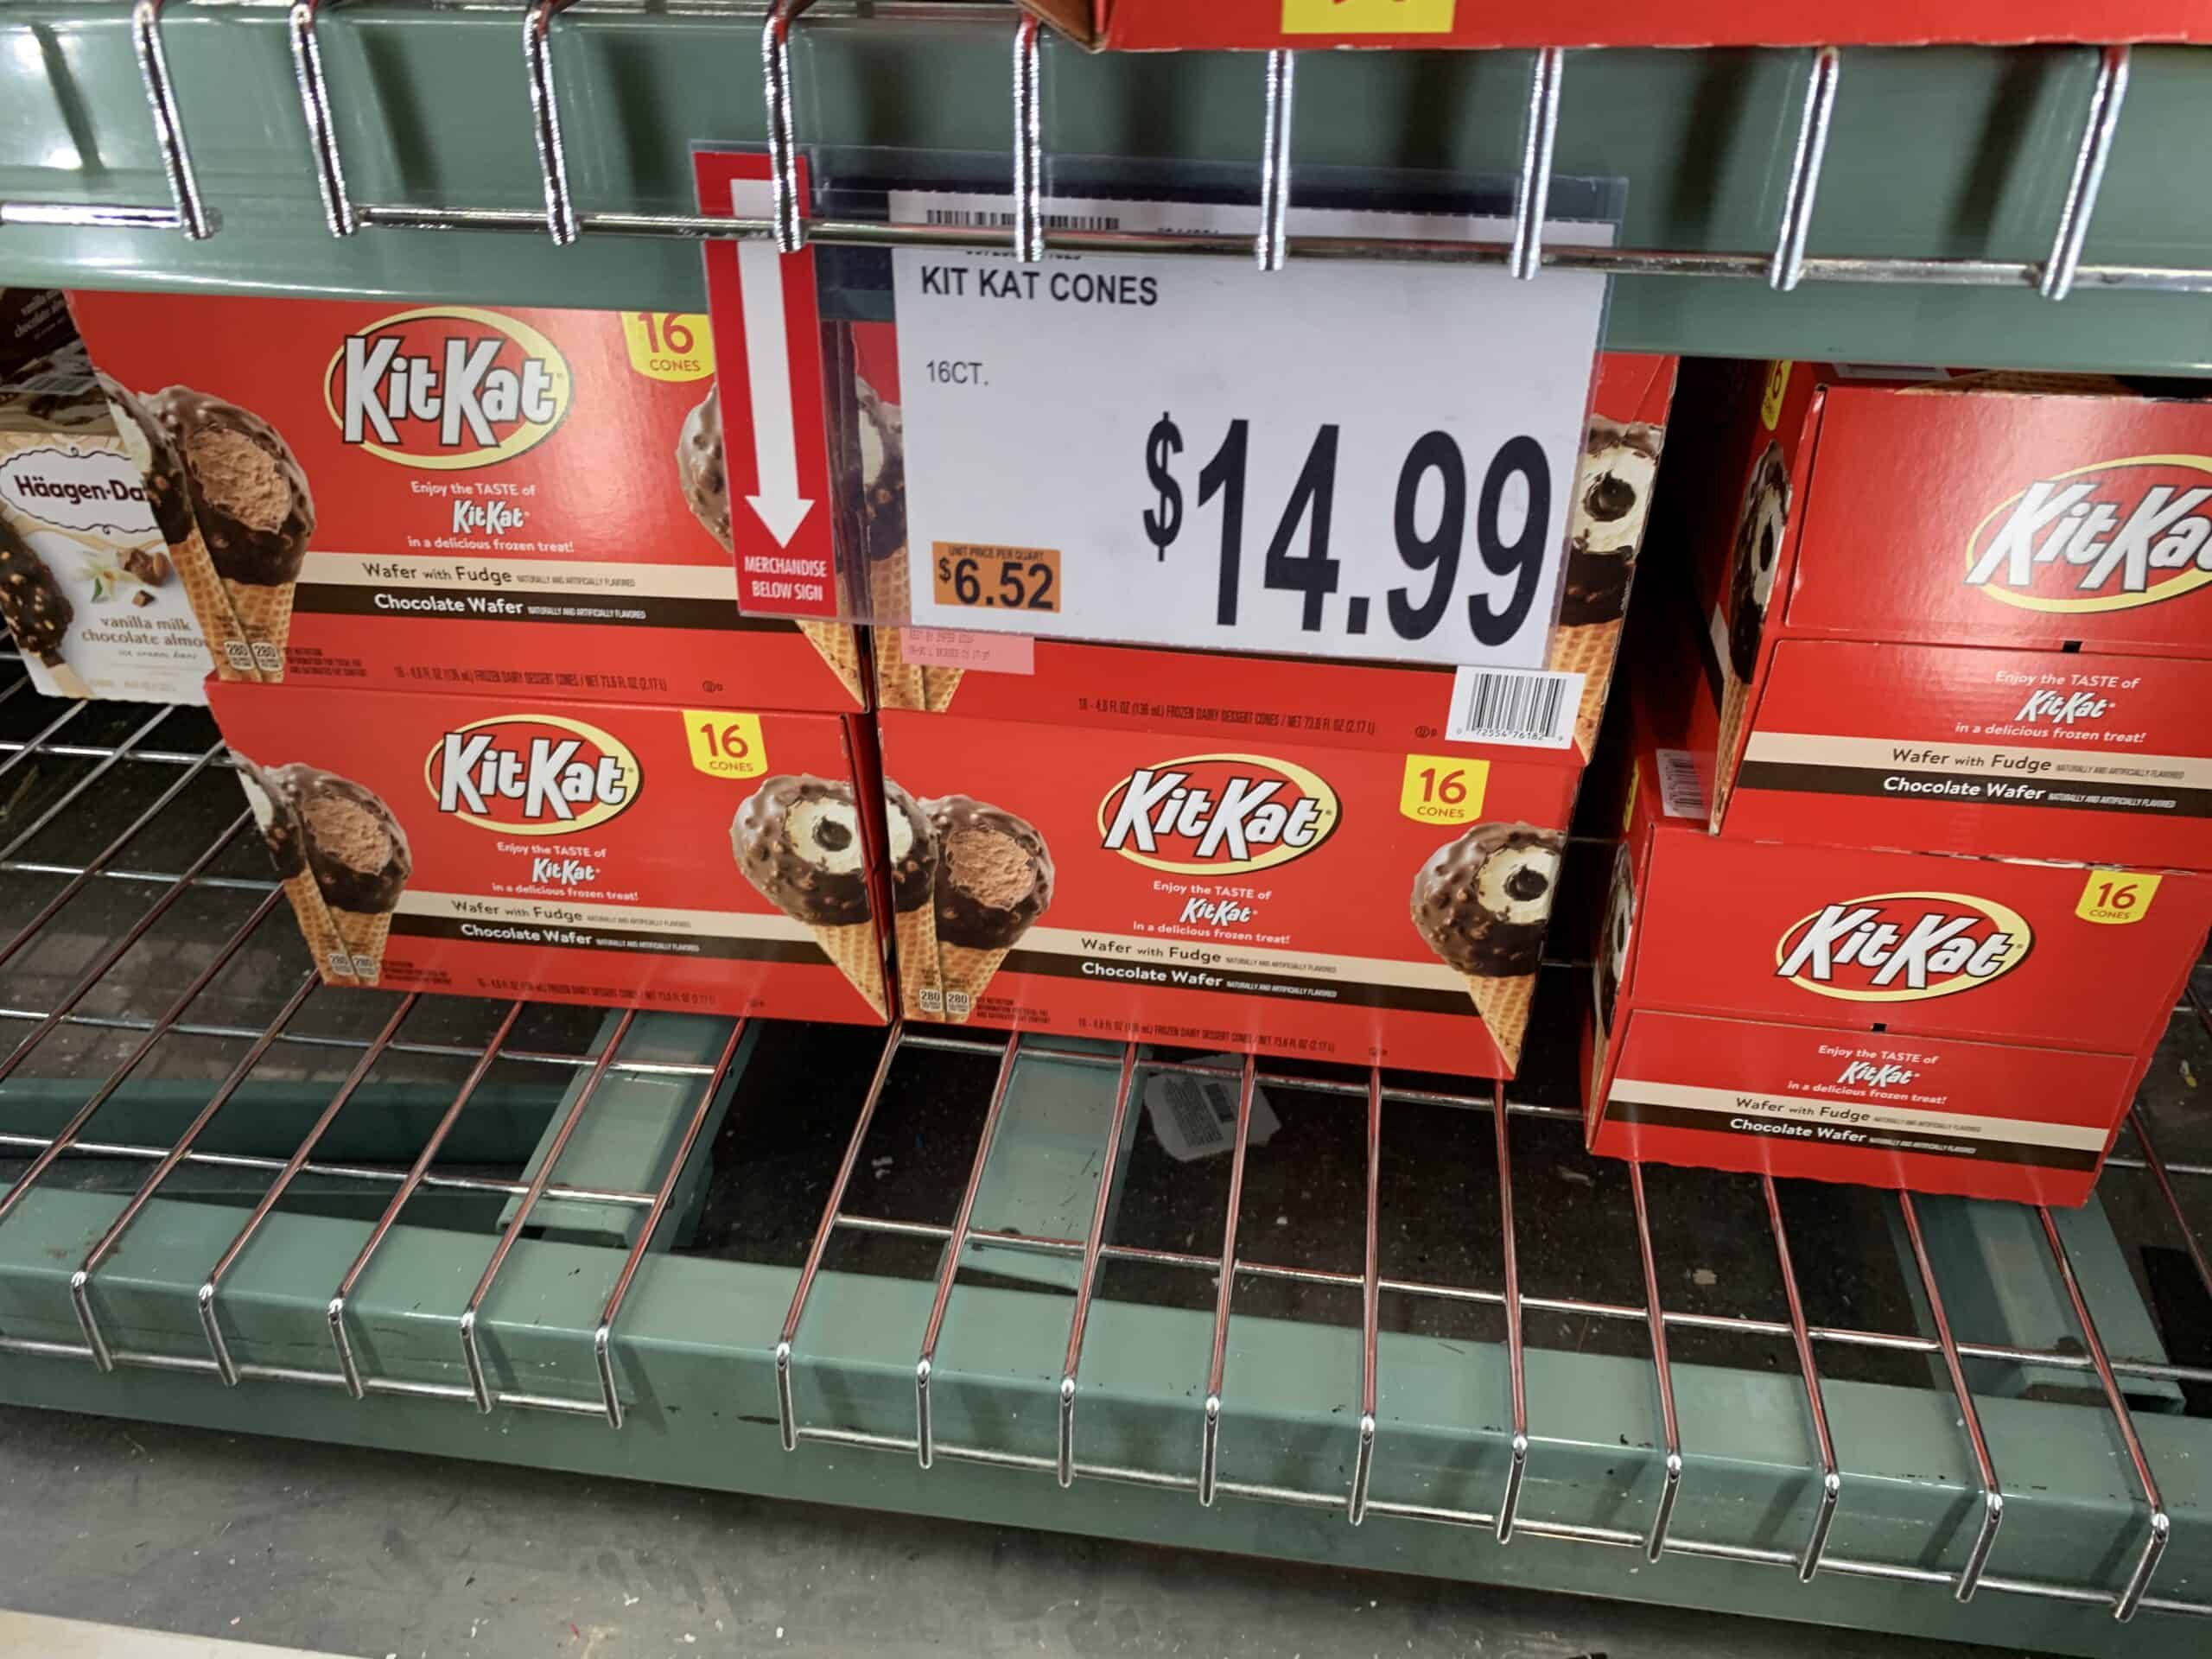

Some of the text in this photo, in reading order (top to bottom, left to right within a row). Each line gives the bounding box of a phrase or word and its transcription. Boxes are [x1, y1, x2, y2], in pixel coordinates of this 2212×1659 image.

[921, 265, 1158, 306] KIT KAT CONES
[637, 312, 694, 354] 16
[650, 359, 700, 372] CONES
[926, 360, 988, 385] 16CT.
[14, 475, 145, 505] Häagen-Da
[411, 481, 537, 497] Enjoy the TASTE of
[1143, 411, 1552, 647] $14.99
[1964, 480, 2212, 594] KitKa
[408, 536, 575, 553] in a delicious frozen treat!
[362, 563, 416, 580] Wafer
[423, 569, 452, 581] with
[455, 566, 512, 586] Fudge
[744, 556, 827, 578] MERCHANDISE
[752, 580, 823, 601] BELOW SIGN
[938, 557, 1053, 609] $6.52
[374, 594, 465, 613] Chocolate
[467, 597, 523, 615] Wafer
[100, 616, 192, 631] vanilla milk
[81, 629, 206, 647] chocolate almo
[1995, 671, 2141, 689] Enjoy the TASTE of
[701, 723, 748, 758] 16
[1955, 722, 1970, 733] in
[1985, 724, 2048, 738] delicious
[2052, 728, 2099, 741] frozen
[2103, 730, 2146, 743] treat!
[709, 760, 753, 772] CONES
[1892, 747, 1950, 765] Wafer
[1955, 755, 1985, 767] with
[1991, 754, 2052, 773] Fudge
[1420, 768, 1467, 804] 16
[1883, 777, 1981, 796] Chocolate
[1986, 783, 2046, 801] Wafer
[1417, 805, 1465, 818] CONES
[498, 842, 607, 858] Enjoy the TASTE of
[492, 882, 504, 892] in
[516, 884, 565, 896] delicious
[568, 887, 604, 899] frozen
[607, 891, 639, 901] treat!
[1154, 880, 1272, 900] Enjoy the TASTE of
[2098, 882, 2139, 909] 16
[451, 899, 499, 915] Wafer
[505, 908, 530, 918] with
[533, 906, 582, 923] Fudge
[2089, 909, 2130, 919] CONES
[461, 924, 541, 943] Chocolate
[543, 931, 592, 946] Wafer
[1147, 924, 1154, 932] a
[1158, 924, 1210, 938] delicious
[1214, 928, 1252, 941] frozen
[1256, 933, 1290, 944] treat!
[1081, 938, 1131, 954] Wafer
[1137, 946, 1163, 957] with
[1169, 947, 1222, 964] Fudge
[1082, 961, 1166, 982] Chocolate
[1172, 969, 1223, 988] Wafer
[921, 991, 940, 1001] 280
[948, 994, 968, 1004] 280
[1819, 1046, 1940, 1065] Enjoy the TASTE of
[1787, 1081, 1799, 1090] in
[1813, 1084, 1866, 1096] delicious
[1869, 1089, 1908, 1101] frozen
[1911, 1093, 1947, 1105] treat!
[1736, 1097, 1871, 1122] Wafer with Fudge
[1730, 1118, 1866, 1143] Chocolate Wafer
